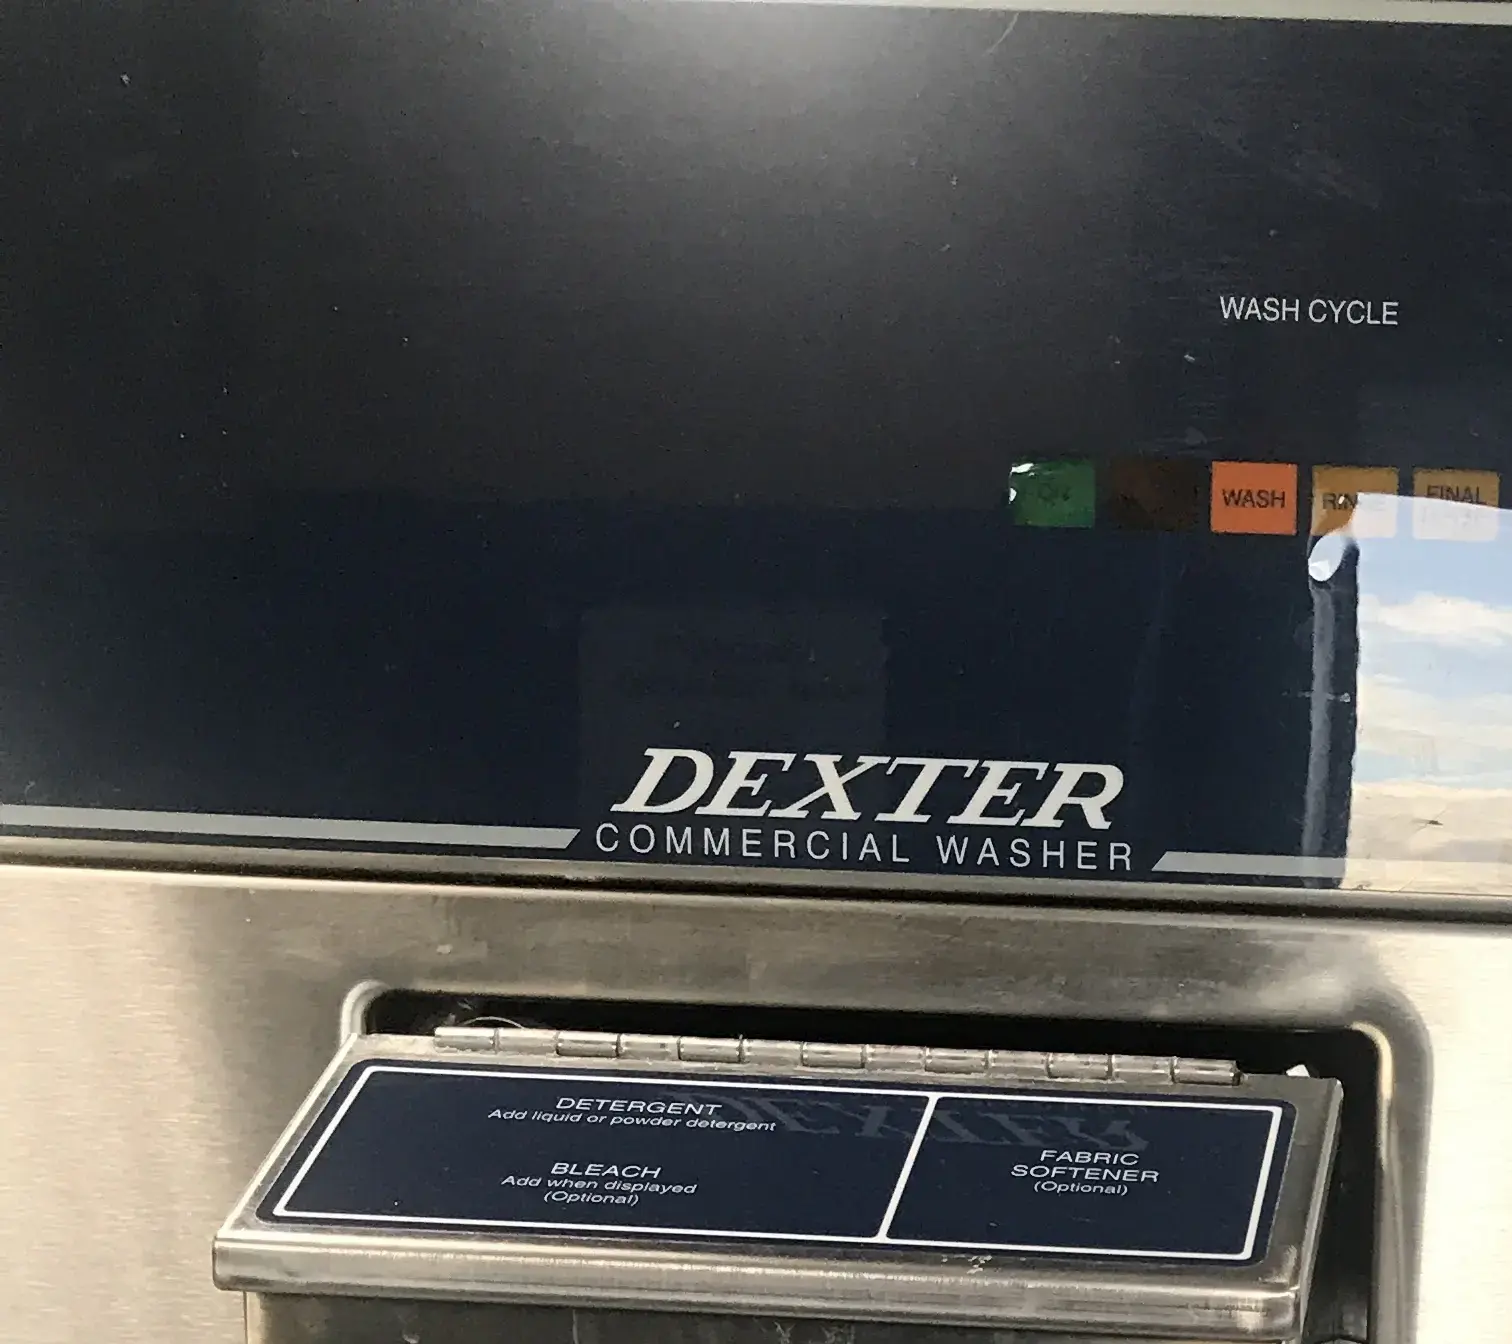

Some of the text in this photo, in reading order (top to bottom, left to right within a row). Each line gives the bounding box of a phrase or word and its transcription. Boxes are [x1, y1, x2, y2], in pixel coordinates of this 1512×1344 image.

[1219, 296, 1399, 326] WASH CYCLE
[1221, 488, 1287, 509] WASH
[1426, 484, 1488, 505] FINAL
[610, 746, 1125, 830] DEXTER
[595, 822, 1132, 872] COMMERCIAL WASHER
[555, 1097, 722, 1116] DETERGENT
[487, 1108, 777, 1132] Add liquid or powder detergent
[1039, 1149, 1140, 1166] FABRIC
[550, 1162, 662, 1179] BLEACH
[1010, 1164, 1160, 1183] SOFTENER
[500, 1175, 698, 1195] Add when displayed
[1033, 1180, 1129, 1196] (Optional)
[543, 1190, 640, 1206] (Optional)
